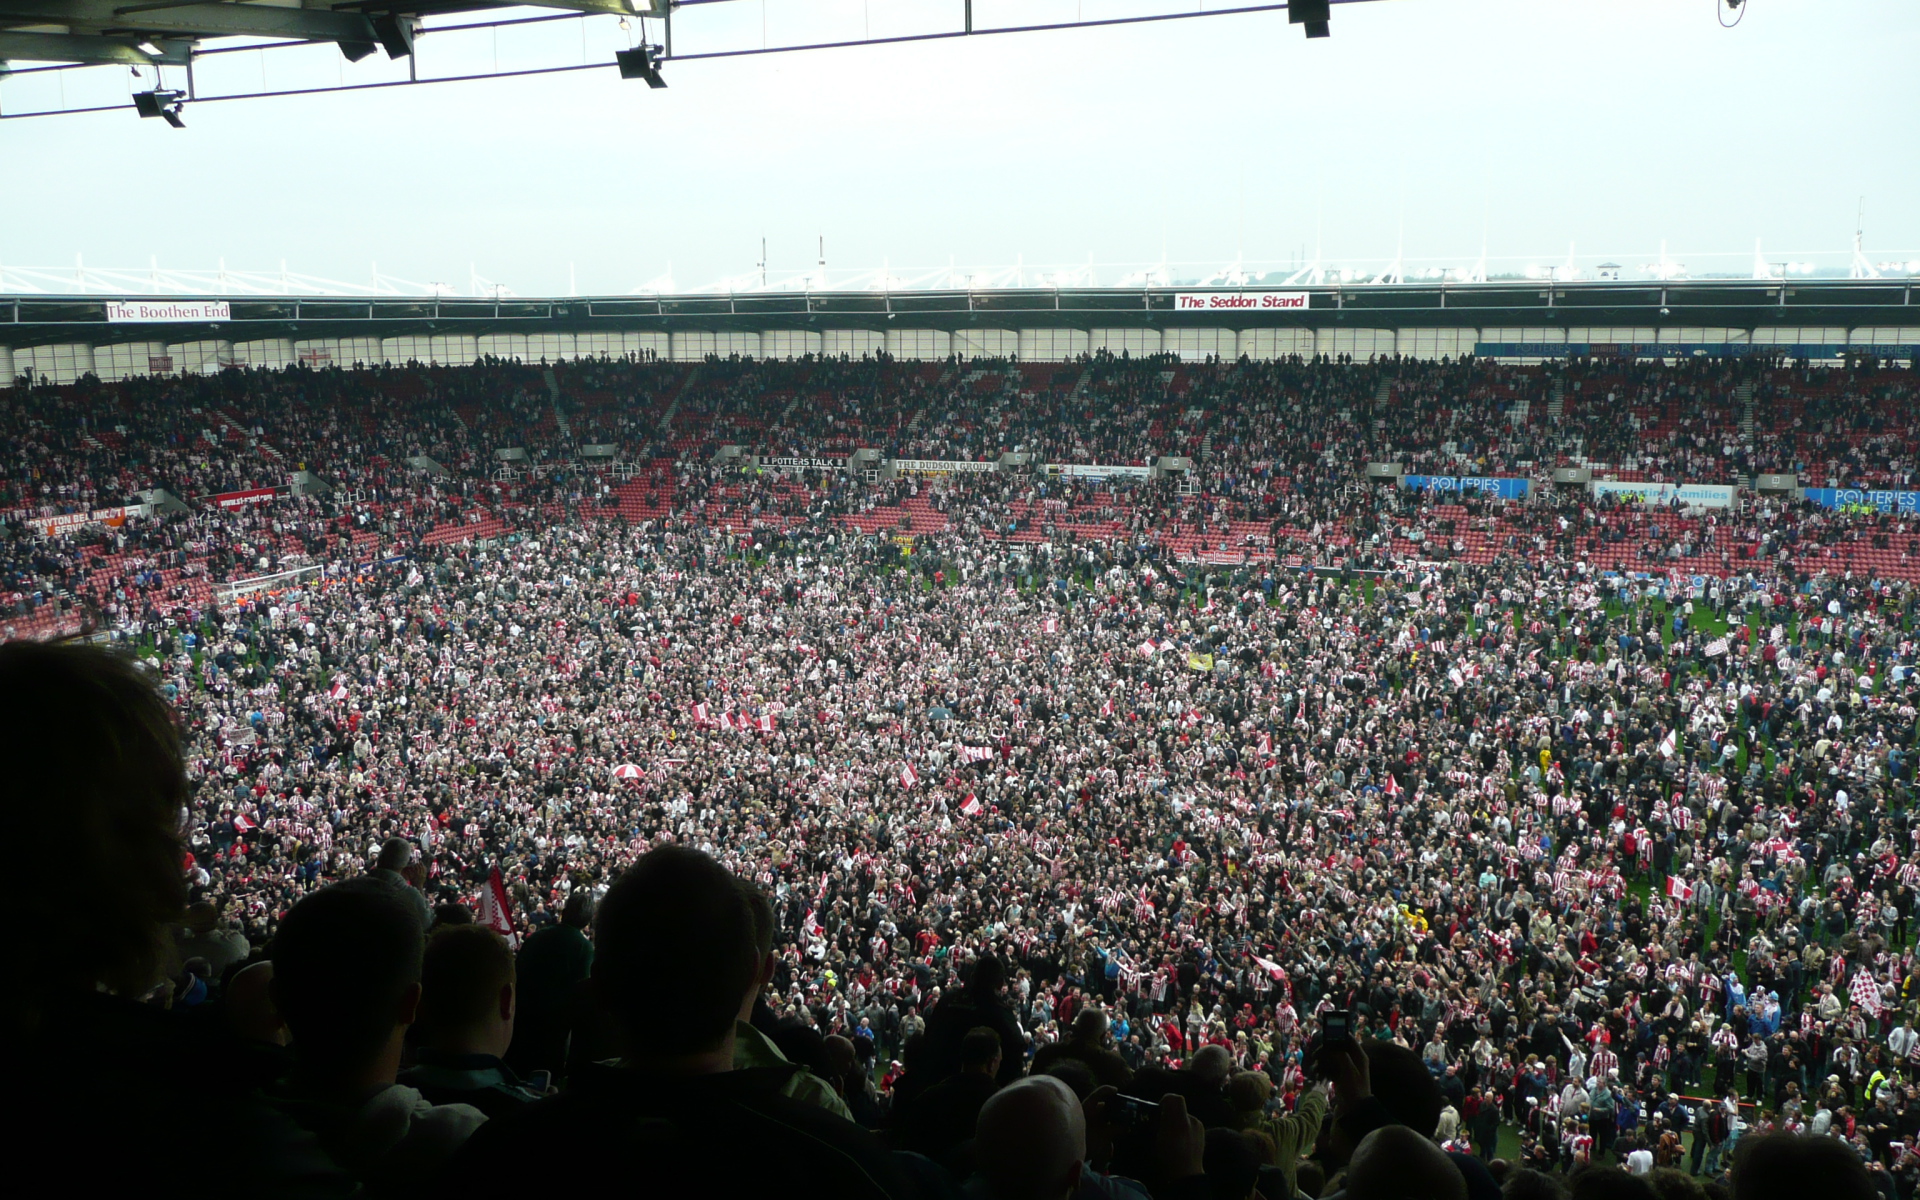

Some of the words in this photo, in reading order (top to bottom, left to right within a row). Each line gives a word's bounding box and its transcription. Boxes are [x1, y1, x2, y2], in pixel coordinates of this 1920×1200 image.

[1180, 296, 1205, 308] The
[1210, 295, 1257, 308] Seddon
[1262, 295, 1305, 308] Stand
[107, 305, 135, 318] The
[140, 305, 199, 318] Boothen
[204, 305, 229, 318] End
[1621, 344, 1680, 352] POTERIES
[771, 457, 810, 466] POTTERS
[811, 458, 834, 466] TALK
[898, 461, 916, 469] THE
[919, 461, 956, 470] DUDSON
[960, 462, 992, 471] GROUP
[1598, 486, 1668, 499] Sting
[1672, 488, 1728, 499] Families
[1835, 490, 1916, 505] POTTERIES
[28, 515, 71, 528] DRAYTON
[73, 509, 121, 523] BEAMOT
[55, 520, 101, 534] SERVI
